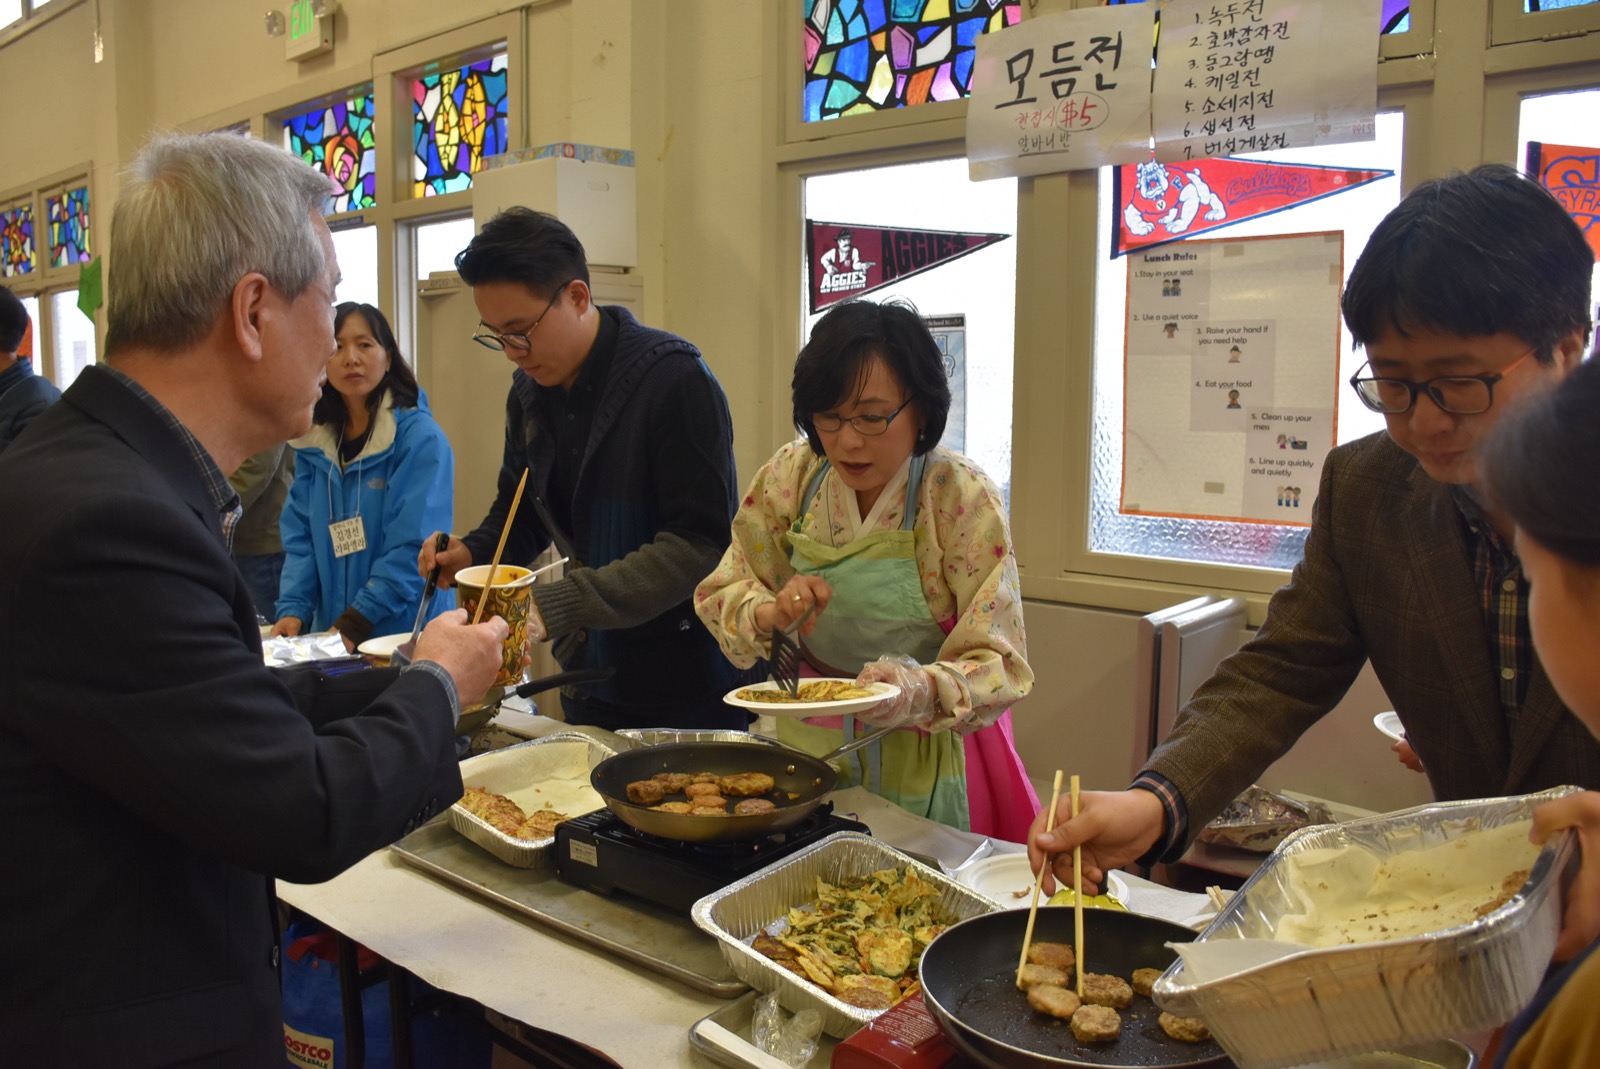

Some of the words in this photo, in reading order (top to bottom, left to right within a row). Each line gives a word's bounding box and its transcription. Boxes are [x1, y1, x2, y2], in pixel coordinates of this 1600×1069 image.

[1208, 0, 1264, 27] 녹두전
[1188, 37, 1202, 47] 2.
[1207, 21, 1290, 50] 호박감자전
[1188, 59, 1199, 70] 3.
[1205, 45, 1275, 72] 동그랑땡
[994, 31, 1122, 109] 모듬전
[1184, 77, 1196, 89] 4.
[1204, 67, 1261, 91] 케일전
[1184, 101, 1195, 113] 5.
[1202, 89, 1274, 115] 소세지전
[1060, 96, 1098, 128] $5
[1183, 121, 1194, 138] 6.
[1183, 144, 1195, 160] 7.
[1204, 132, 1290, 158] 버섯게살전
[1225, 167, 1312, 205] Bulldogs
[881, 229, 968, 282] AGGIES
[1144, 254, 1171, 263] Lunch
[1173, 253, 1197, 262] Rules
[820, 271, 867, 289] AGGIES
[1163, 270, 1178, 278] your
[1142, 313, 1154, 321] Use
[1162, 313, 1179, 322] quiet
[1206, 326, 1225, 334] Raise
[1226, 327, 1242, 335] your
[1198, 337, 1212, 345] you
[1213, 336, 1231, 344] need
[1232, 336, 1248, 345] help
[1205, 380, 1217, 388] Eat
[1218, 381, 1235, 389] your
[1236, 380, 1252, 388] food
[1261, 412, 1282, 421] Clean
[1295, 415, 1312, 423] your
[1253, 423, 1270, 431] mess
[1259, 457, 1275, 465] Line
[1287, 458, 1314, 468] quickly
[1251, 467, 1265, 475] and
[1266, 468, 1292, 477] quietly
[284, 1035, 331, 1061] OSTCO
